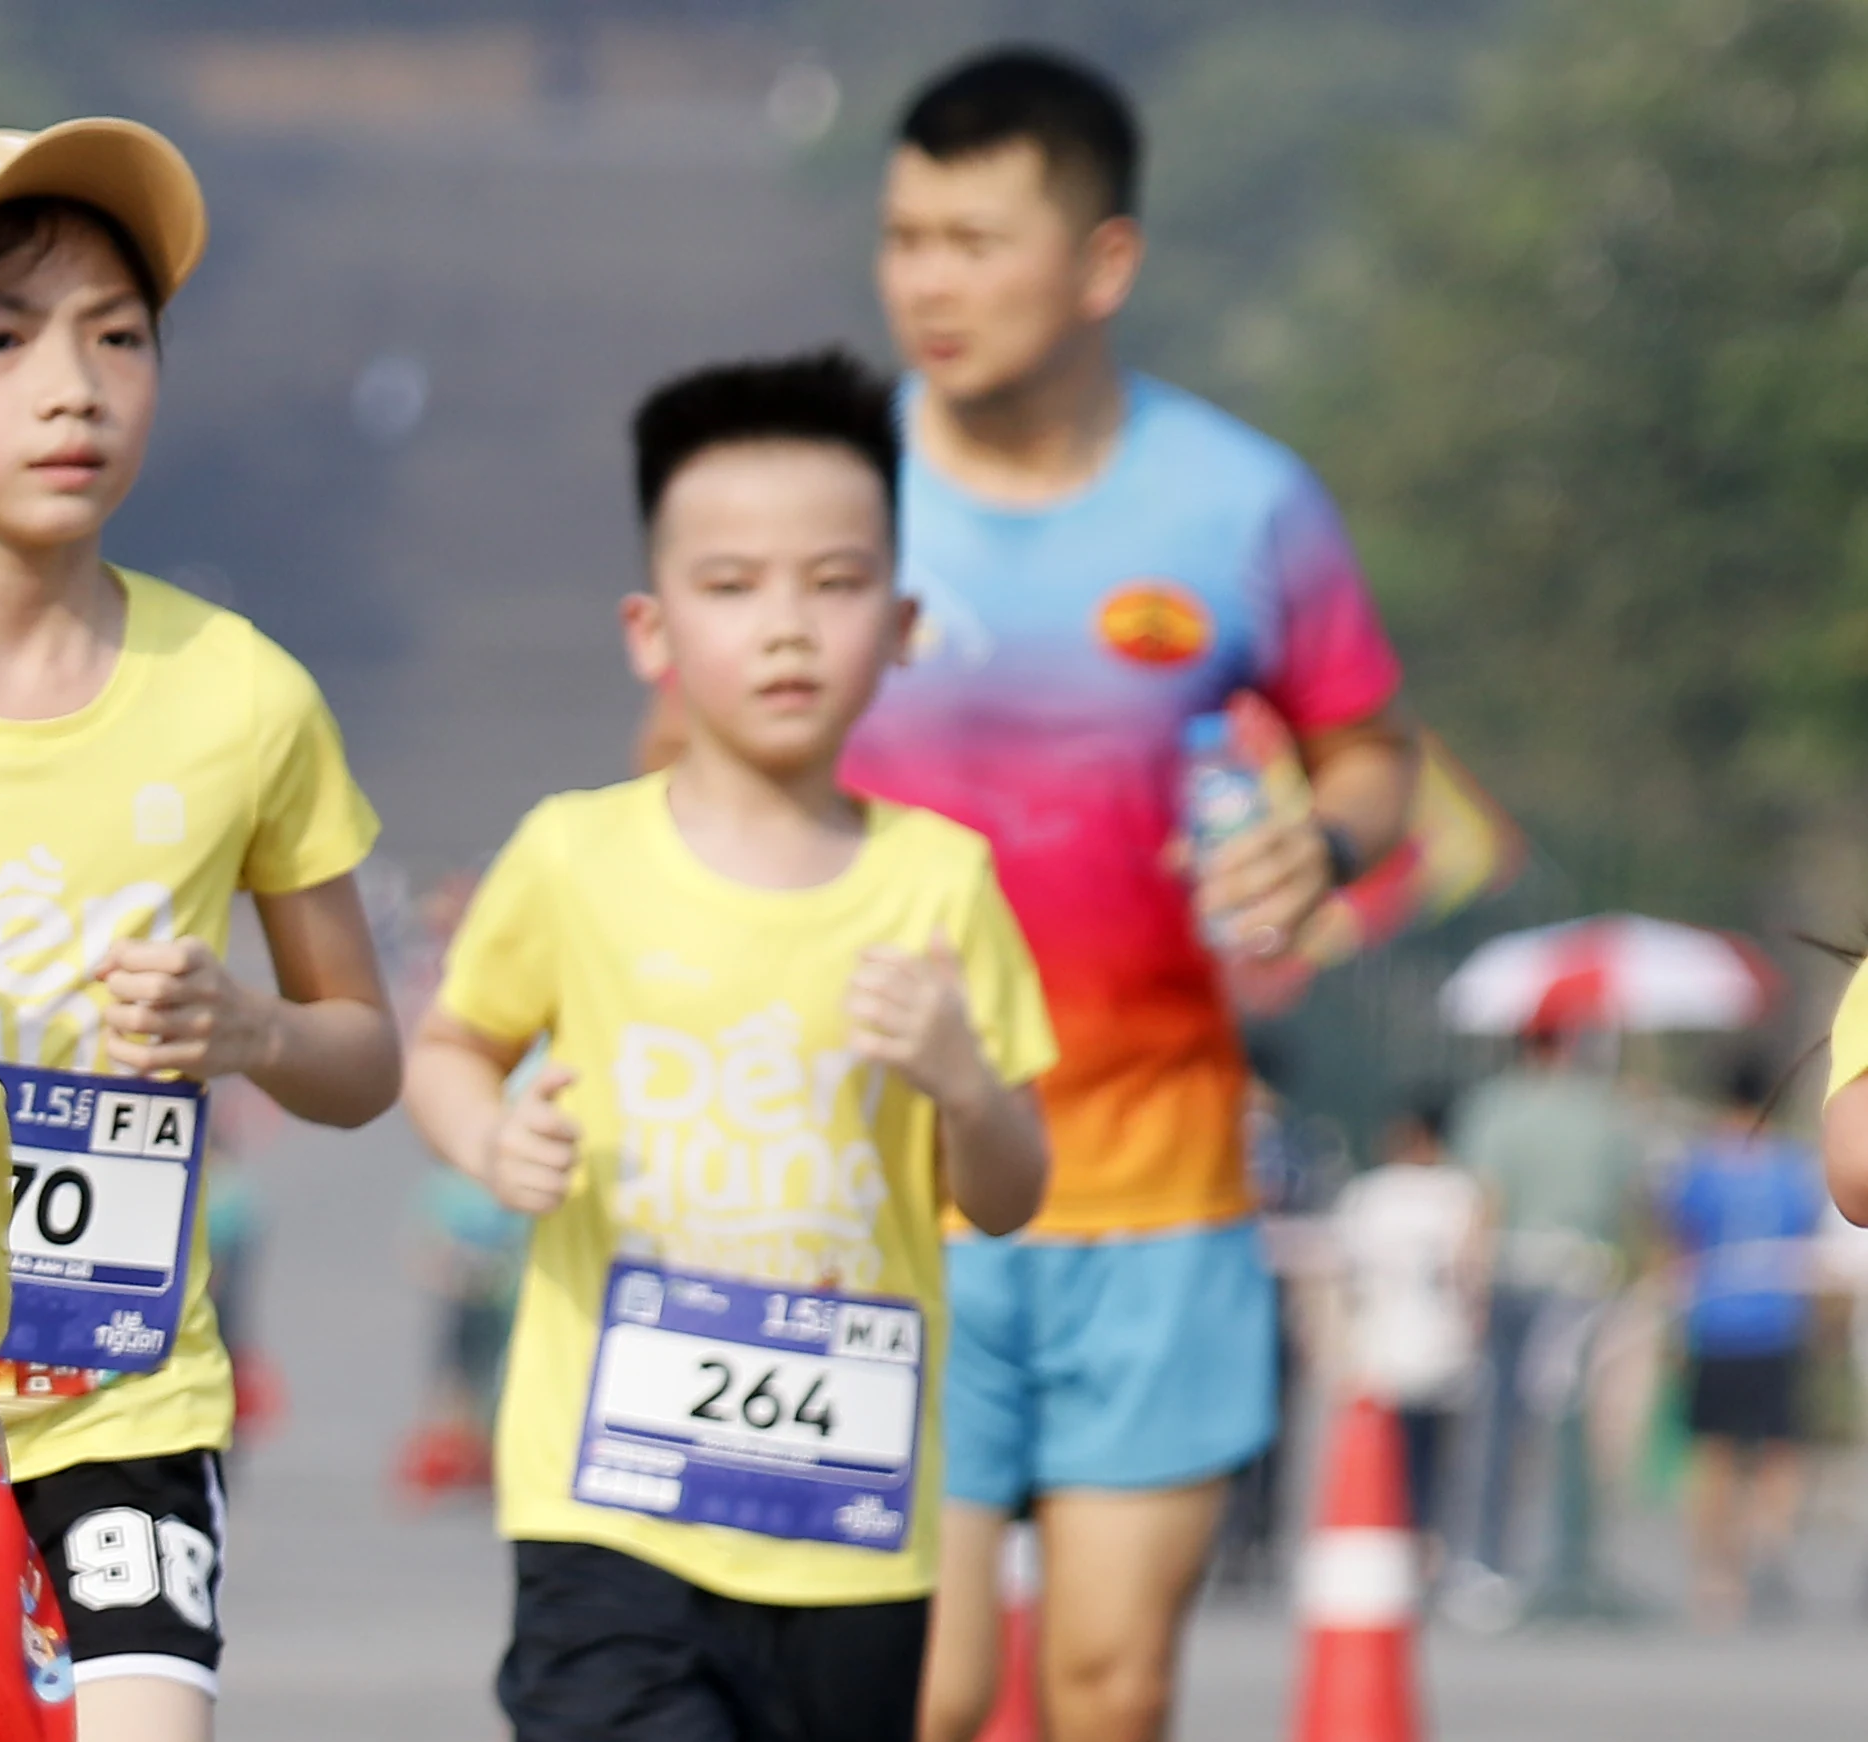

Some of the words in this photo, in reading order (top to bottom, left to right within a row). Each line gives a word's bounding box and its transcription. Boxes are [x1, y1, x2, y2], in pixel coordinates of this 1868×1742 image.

[15, 1080, 75, 1128] 1.5
[109, 1102, 136, 1142] F
[153, 1106, 182, 1147] A
[689, 1353, 834, 1437] 264
[64, 1506, 215, 1632] 98
